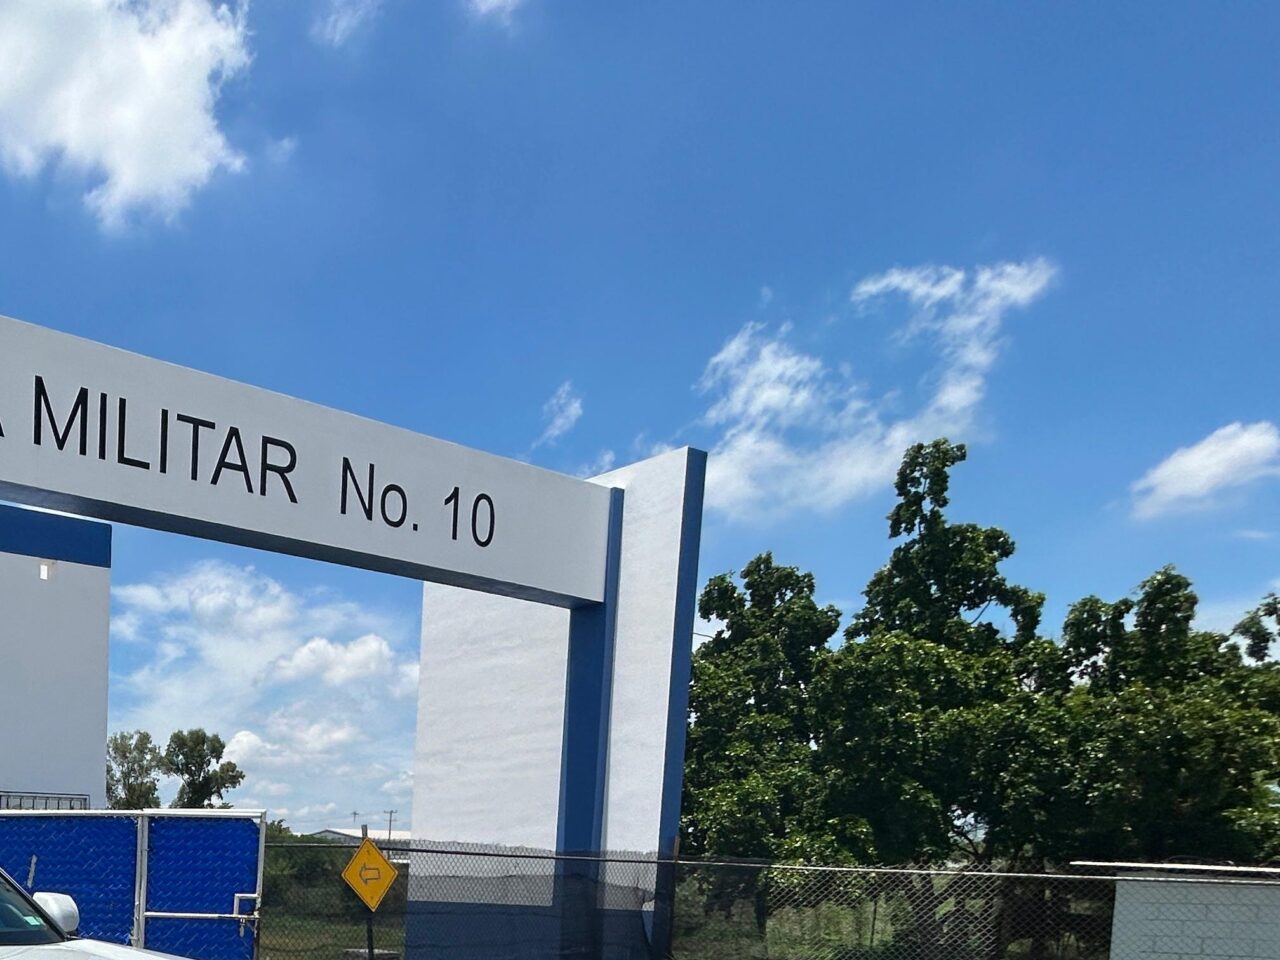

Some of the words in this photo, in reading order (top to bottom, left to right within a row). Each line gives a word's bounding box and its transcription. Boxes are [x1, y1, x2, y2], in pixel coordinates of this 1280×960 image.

[33, 375, 298, 504] MILITAR
[340, 457, 418, 532] No.
[444, 486, 496, 548] 10
